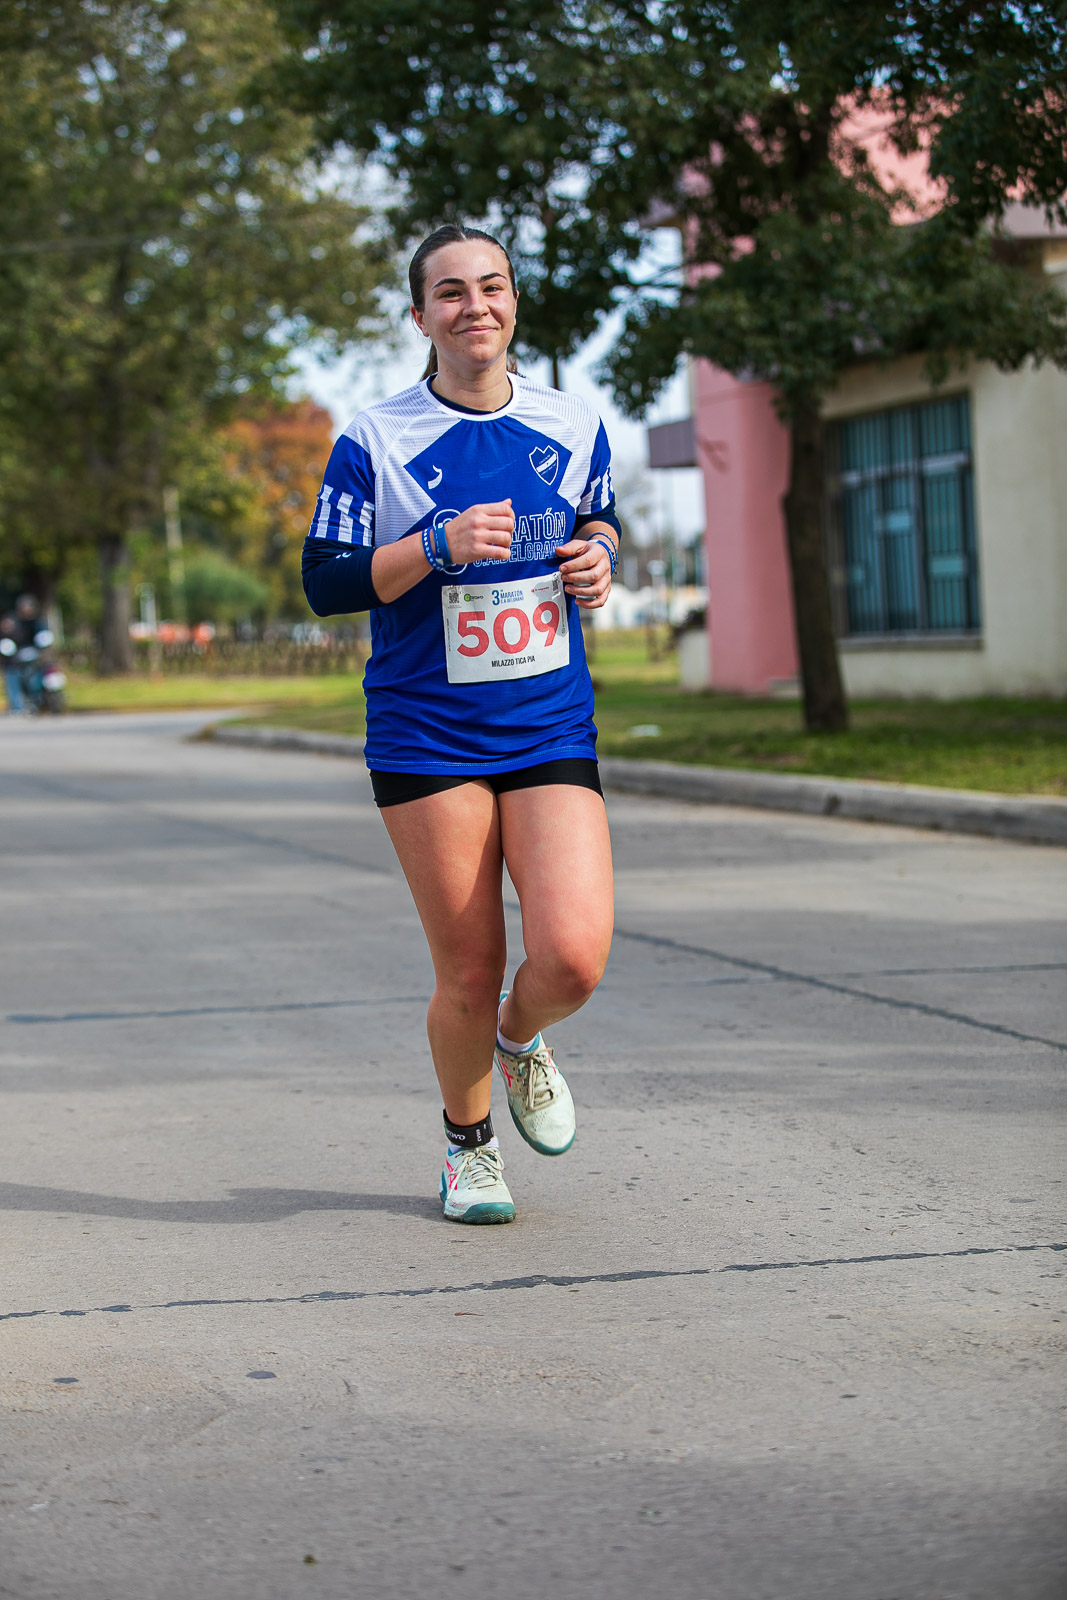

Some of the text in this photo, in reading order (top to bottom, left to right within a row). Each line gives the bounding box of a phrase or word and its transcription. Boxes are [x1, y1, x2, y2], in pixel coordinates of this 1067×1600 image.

[511, 507, 566, 543] ATÓN
[491, 589, 500, 606] 3
[457, 601, 560, 657] 509
[491, 655, 536, 668] MILAZZO TICA PIA
